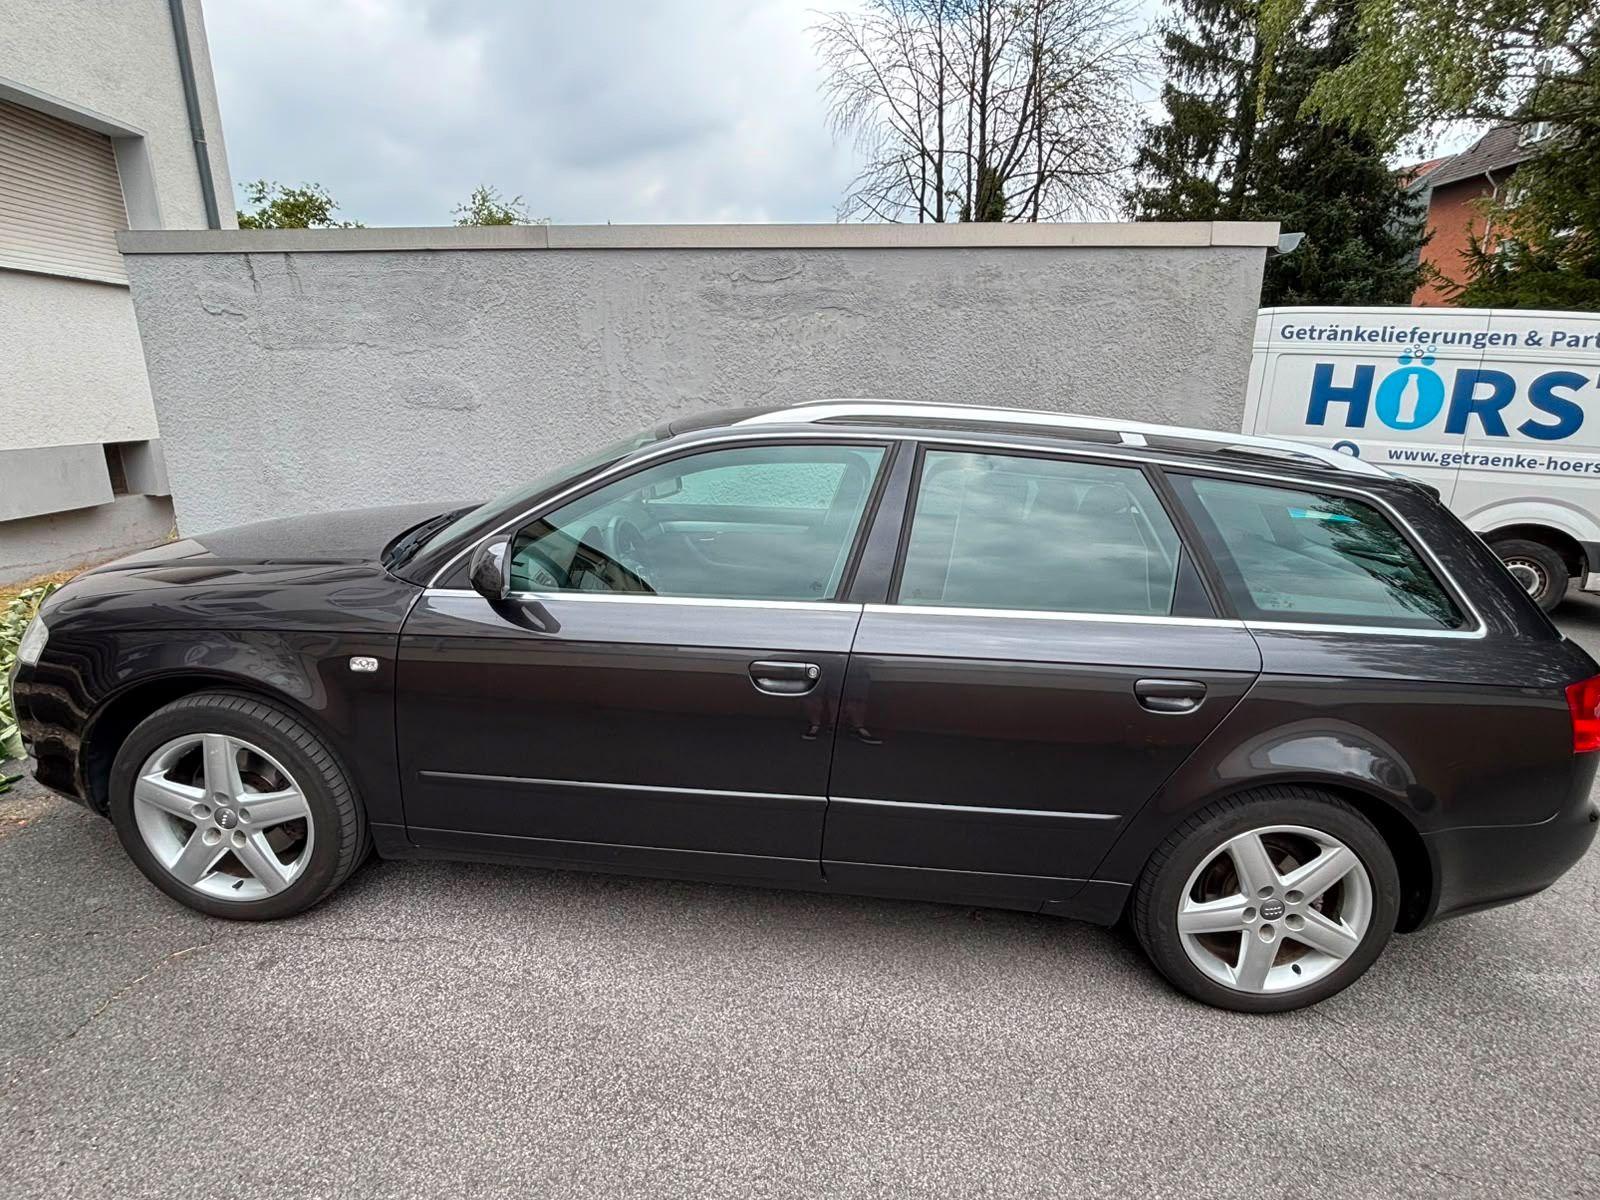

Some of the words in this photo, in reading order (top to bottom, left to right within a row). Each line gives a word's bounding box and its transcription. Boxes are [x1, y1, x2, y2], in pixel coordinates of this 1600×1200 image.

[1280, 324, 1517, 349] Getränkelieferungen
[1524, 330, 1543, 347] &
[1305, 354, 1600, 441] HÖRS
[1388, 449, 1600, 473] www.getraenke-hoers
